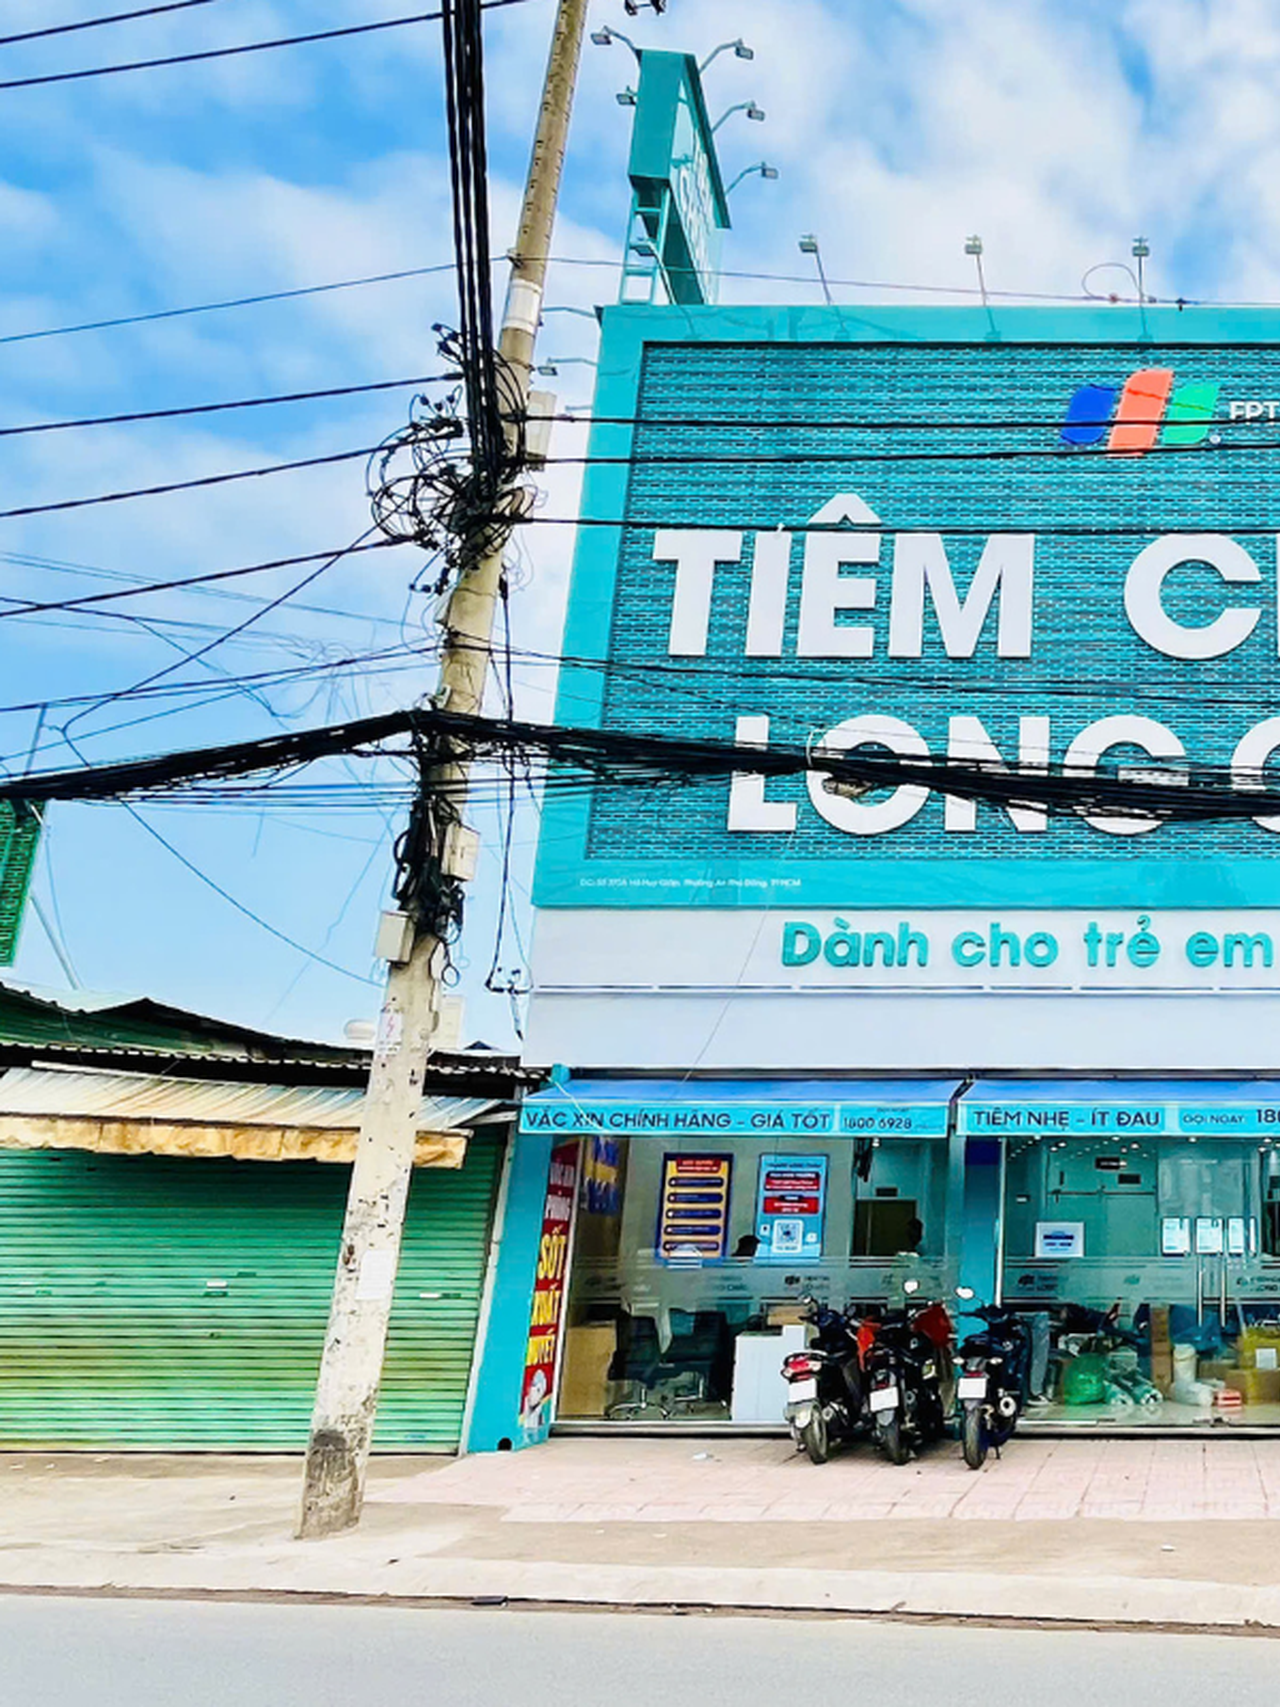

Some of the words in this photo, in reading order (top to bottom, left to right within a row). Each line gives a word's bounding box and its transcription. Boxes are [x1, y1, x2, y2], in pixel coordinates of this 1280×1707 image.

[1229, 401, 1280, 426] FPT
[652, 492, 1036, 659] TIÊM
[727, 714, 1189, 836] LONG
[780, 916, 929, 967] Dành
[951, 921, 1059, 967] cho
[1083, 914, 1161, 968] trẻ
[1184, 931, 1273, 967] em
[609, 1108, 670, 1128] CHÍNH
[750, 1108, 785, 1130] GIÁ
[791, 1107, 831, 1130] TỐT
[842, 1117, 876, 1130] 1800
[877, 1117, 913, 1130] 6928
[973, 1107, 1022, 1127] TIÊM
[1026, 1110, 1070, 1131] NHẸ
[1091, 1107, 1110, 1127] ÍT
[1115, 1110, 1161, 1127] ĐAU
[537, 1224, 567, 1280] SỐT
